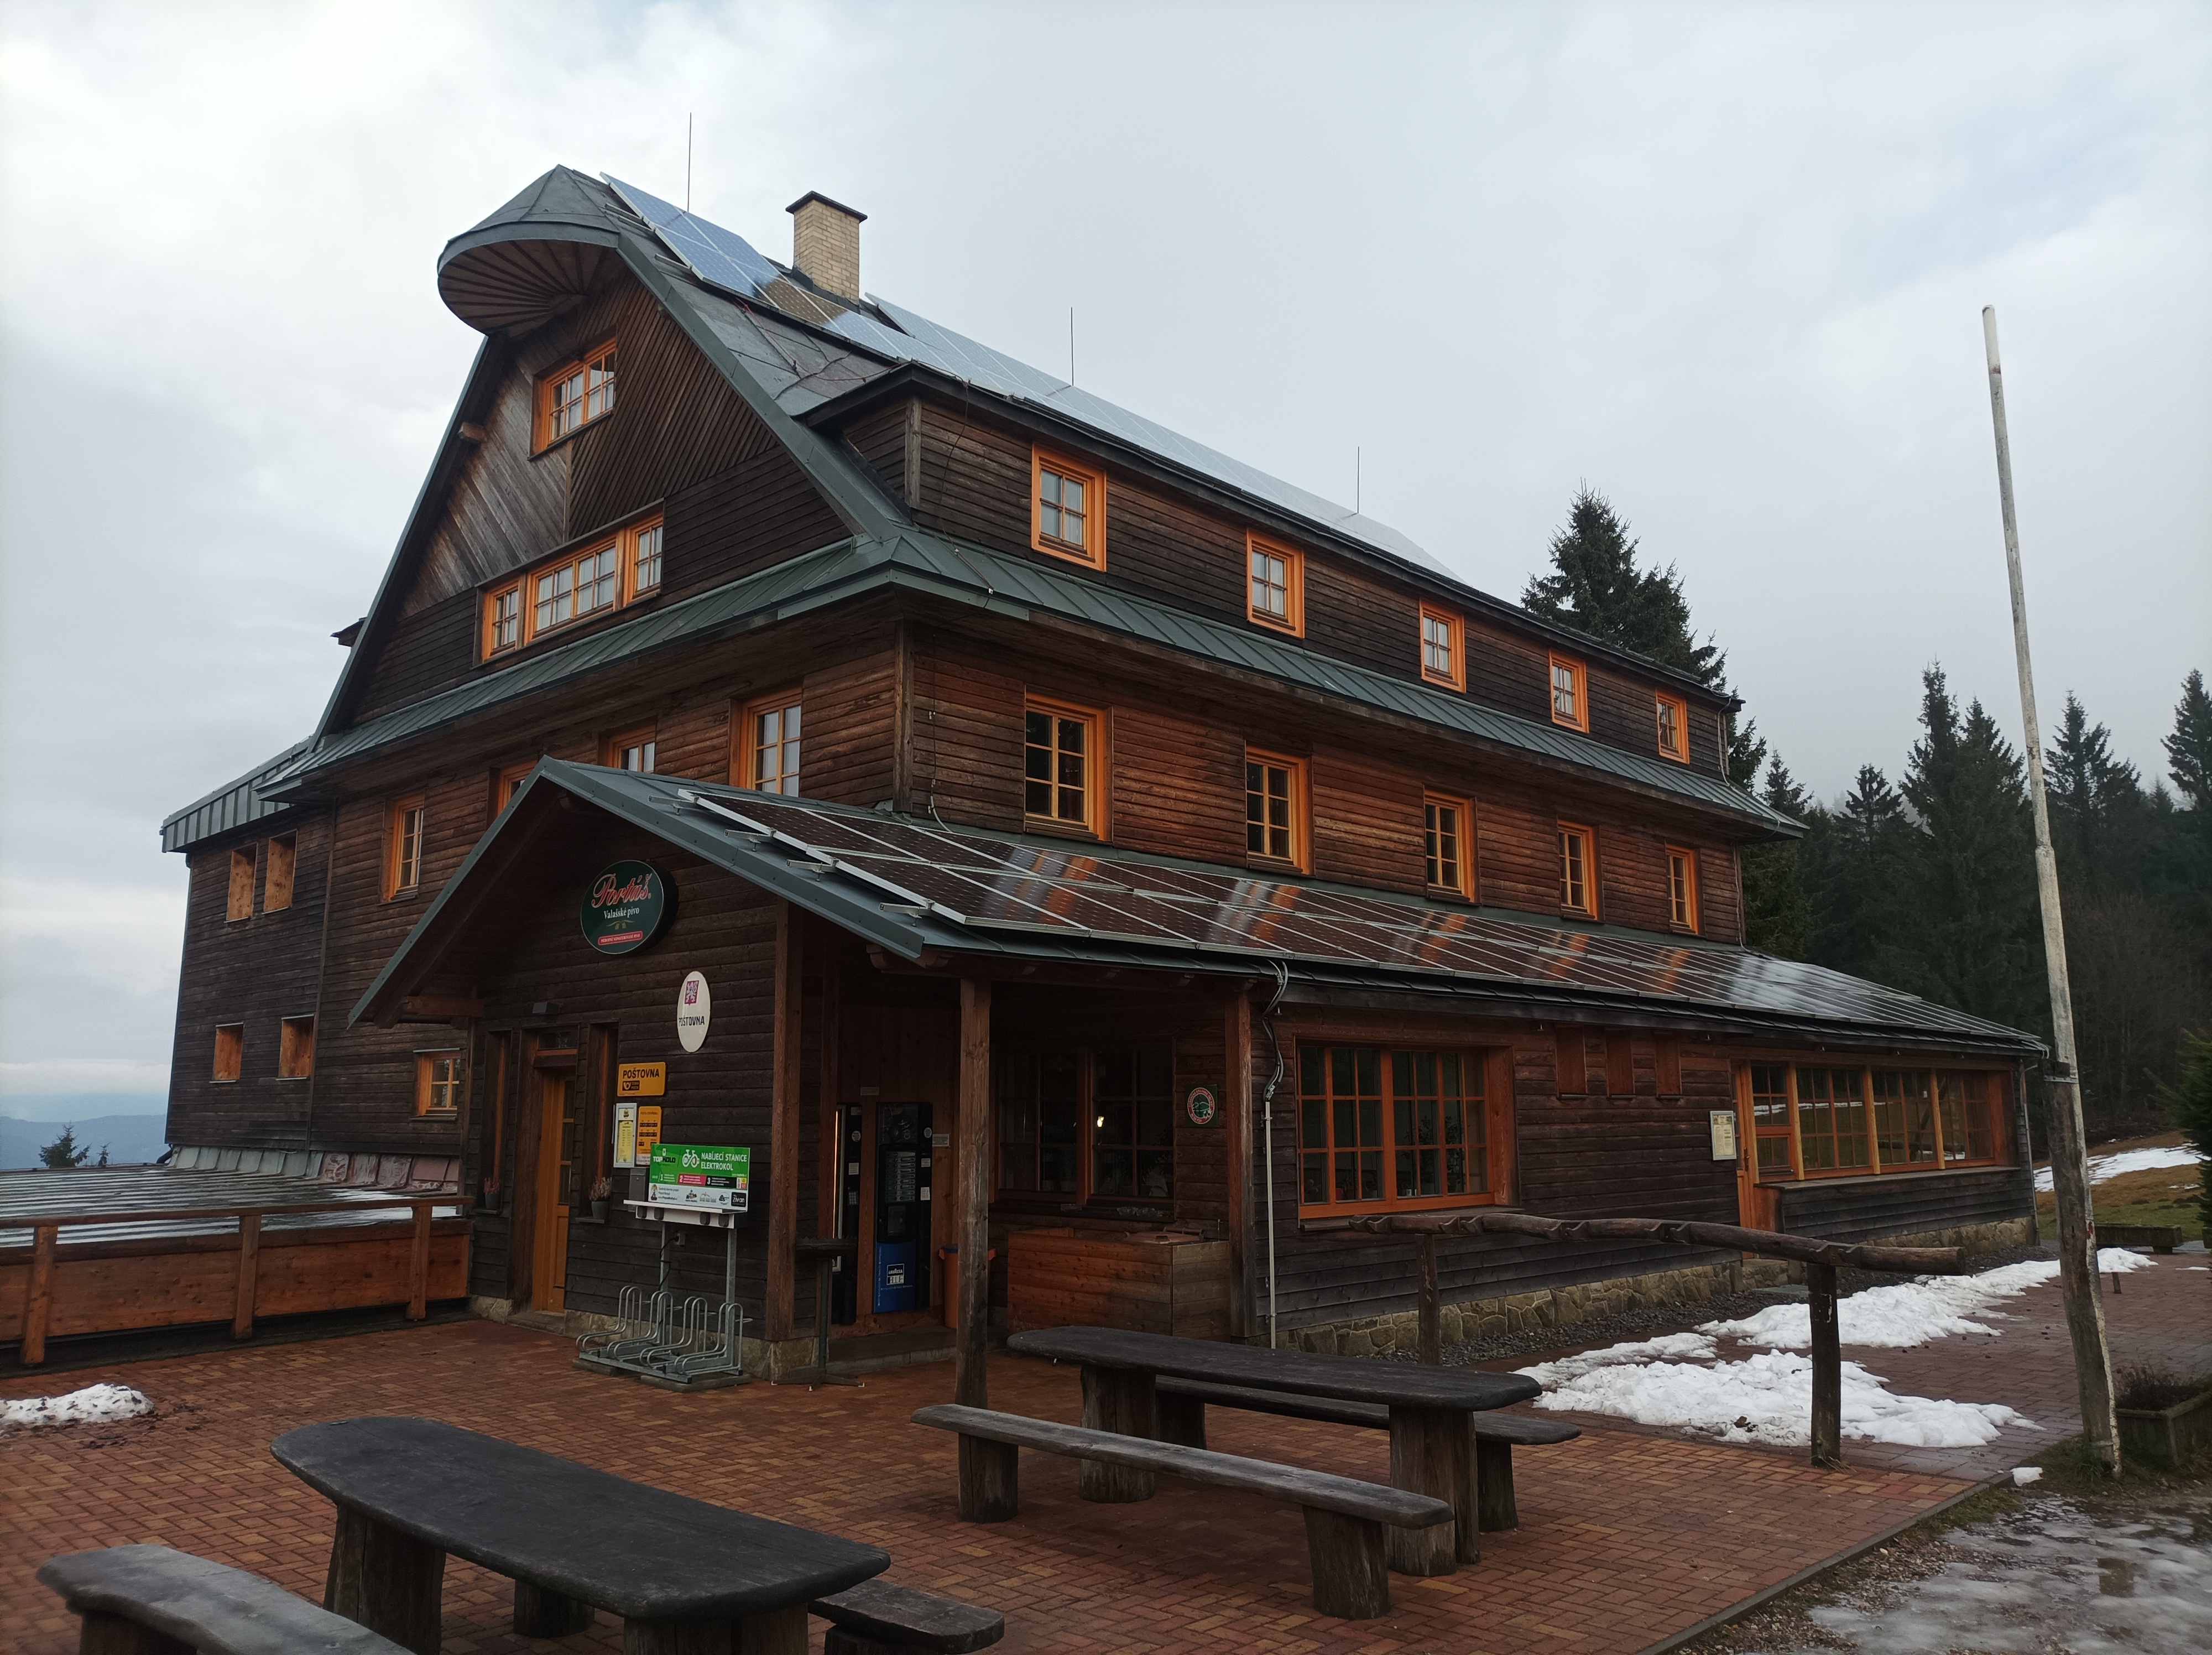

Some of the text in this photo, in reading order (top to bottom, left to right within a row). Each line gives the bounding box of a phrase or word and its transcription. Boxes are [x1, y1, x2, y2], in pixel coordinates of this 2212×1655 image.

[591, 873, 652, 908] Portáš
[604, 907, 639, 919] Valašské pivo
[679, 1015, 705, 1027] POŠTOVNA
[623, 1068, 660, 1079] POŠTOVNA
[701, 1151, 747, 1162] NABÍJECÍ STANICE
[701, 1162, 733, 1171] ELEKTROKOL
